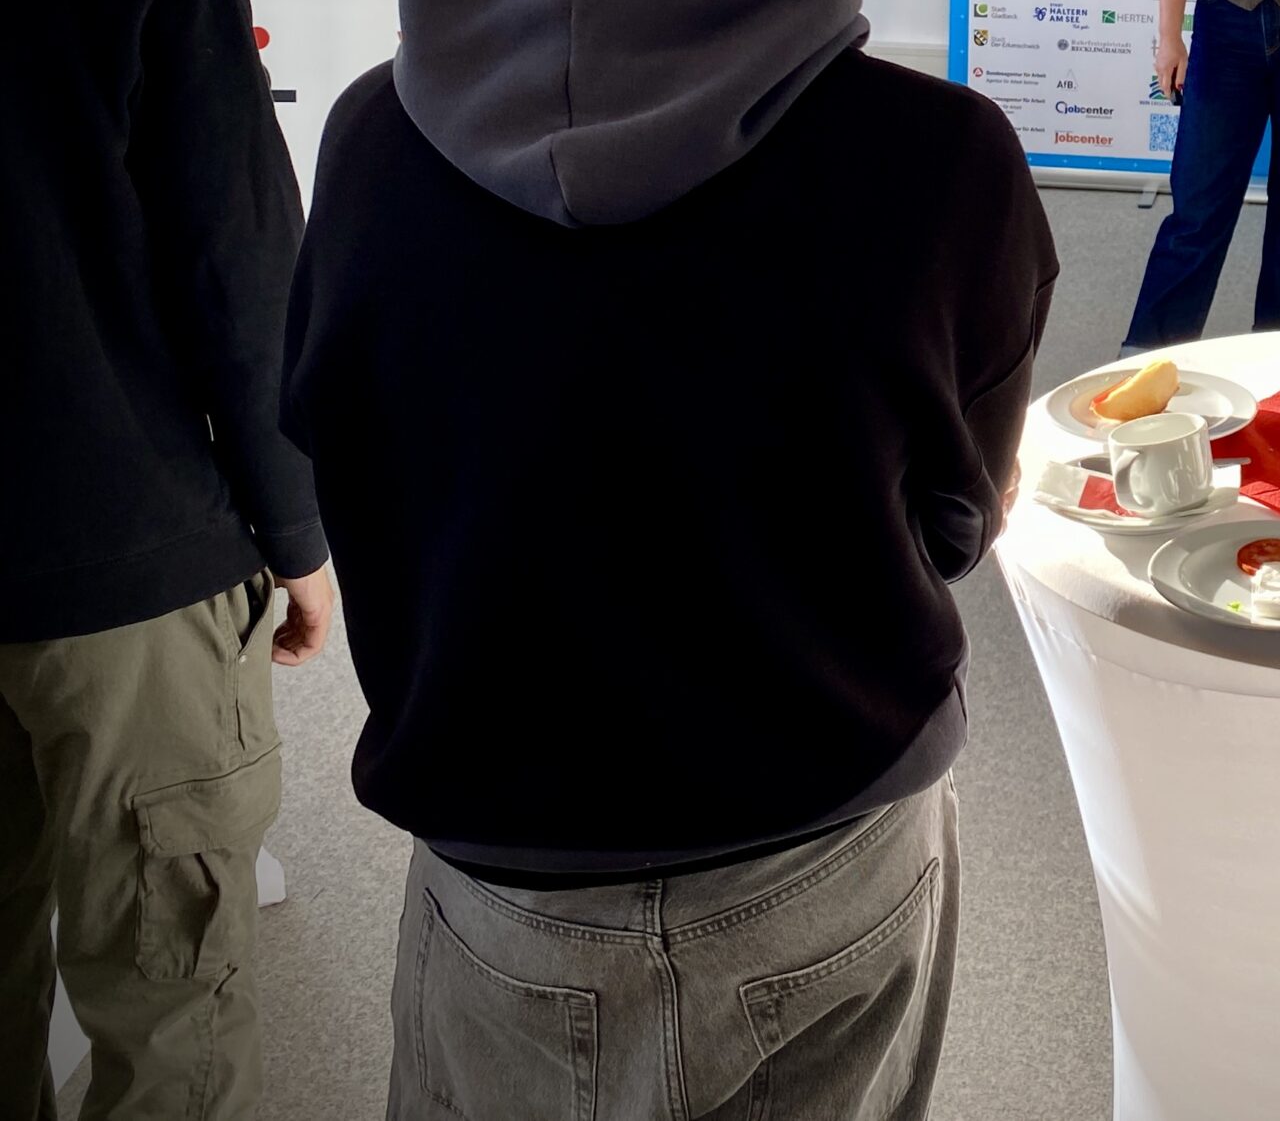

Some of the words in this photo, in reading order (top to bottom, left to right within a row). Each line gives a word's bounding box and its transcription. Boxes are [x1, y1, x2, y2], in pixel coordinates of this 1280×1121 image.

[1050, 8, 1088, 16] HALTERN
[1117, 13, 1154, 24] HERTEN
[1055, 132, 1113, 145] Jobcenter
